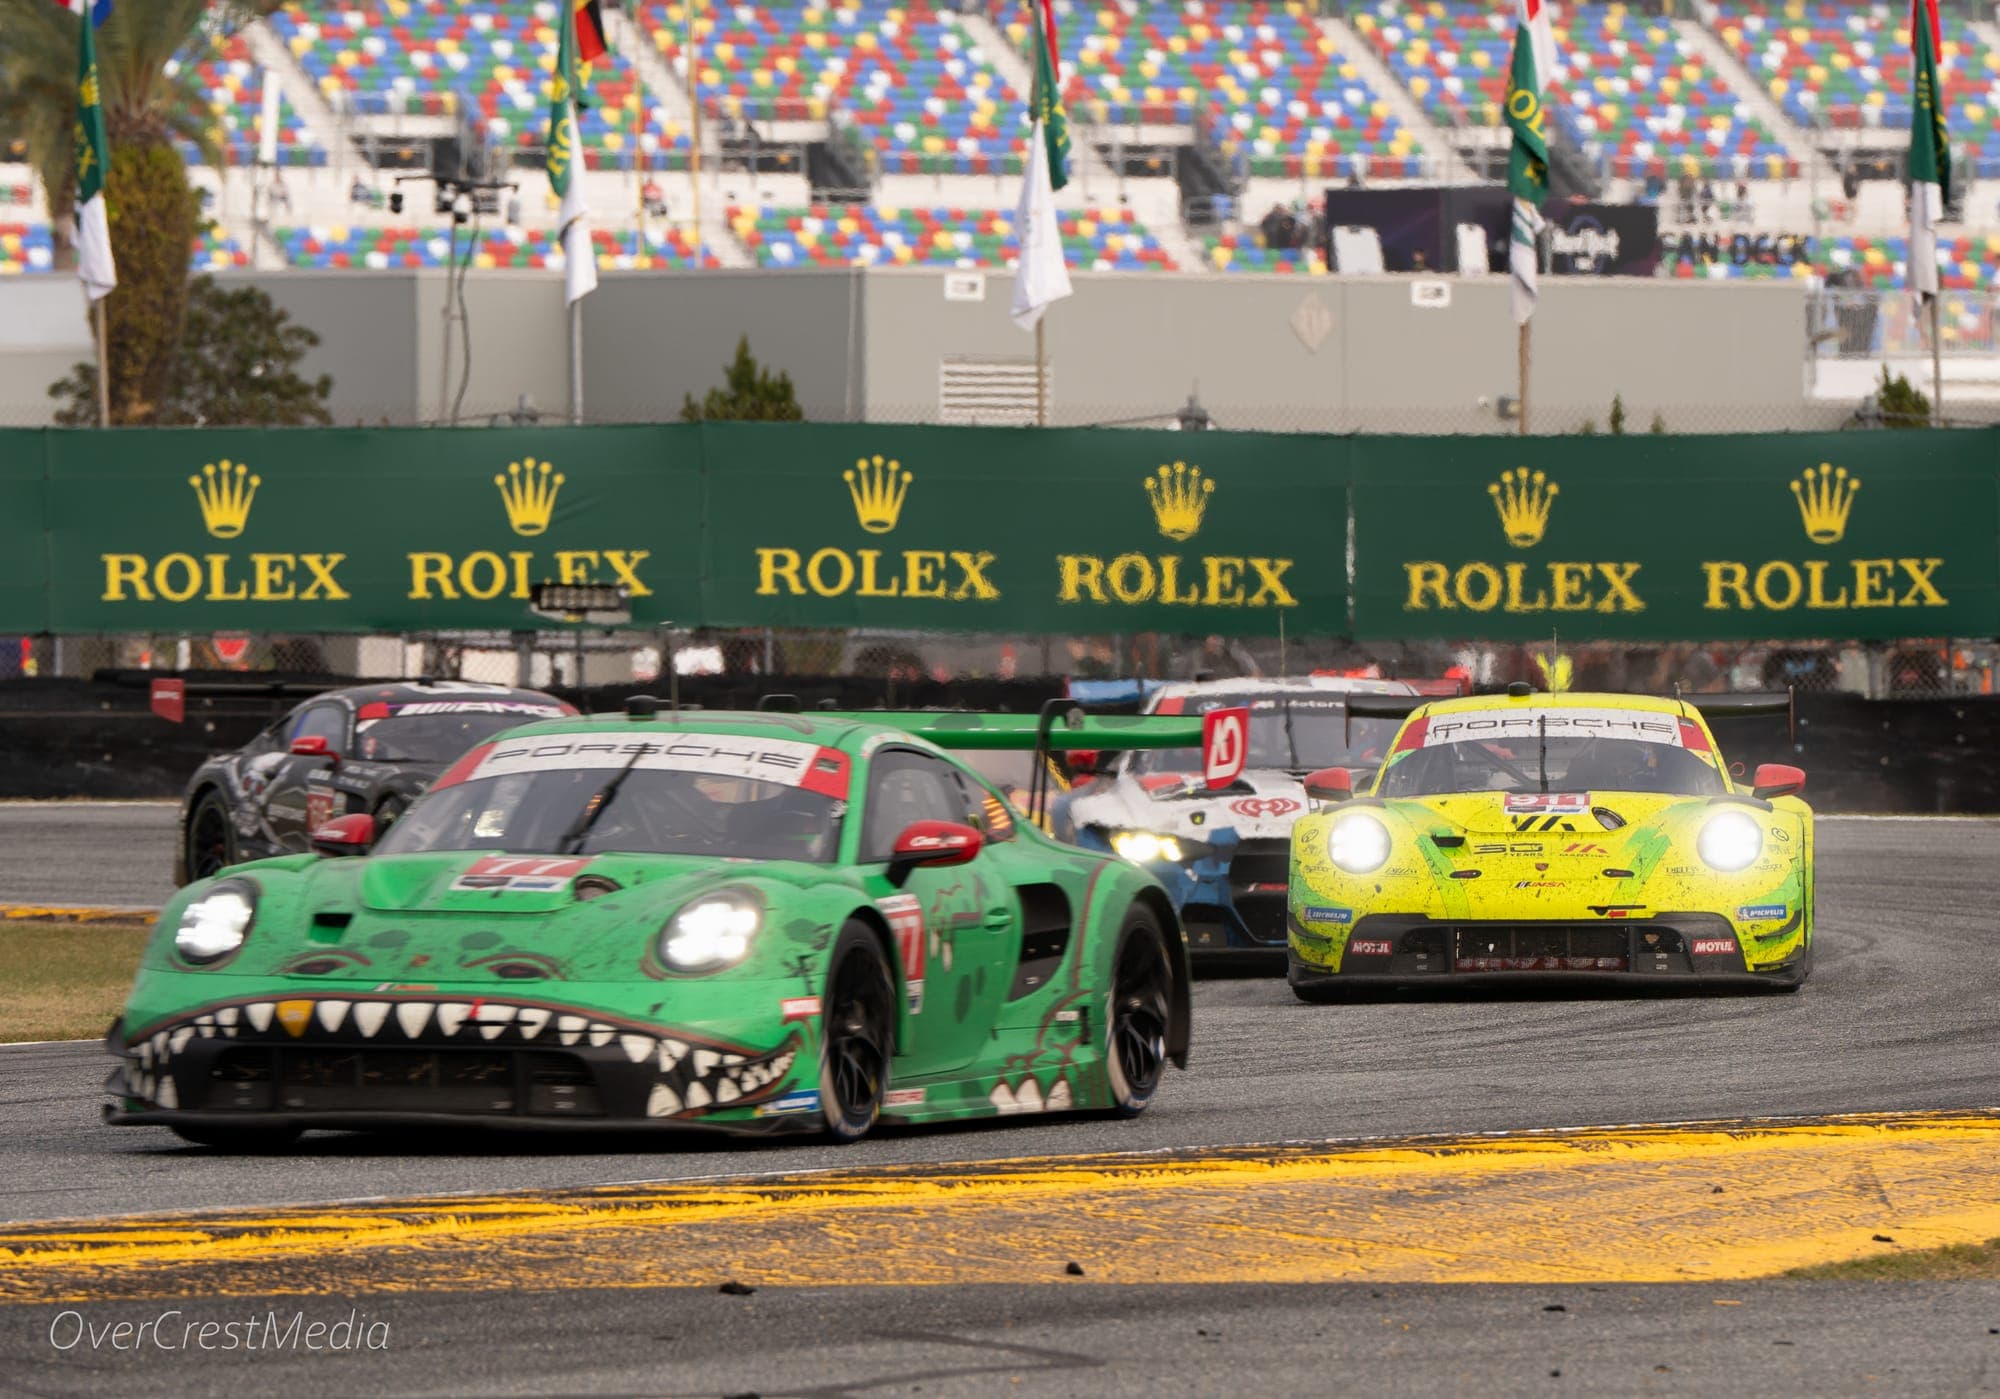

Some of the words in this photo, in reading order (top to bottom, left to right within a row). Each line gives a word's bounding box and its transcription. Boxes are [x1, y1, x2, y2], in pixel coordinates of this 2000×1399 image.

[102, 552, 349, 602] ROLEX
[407, 549, 651, 600] ROLEX
[755, 546, 1000, 601] ROLEX
[1057, 553, 1297, 606] ROLEX
[1404, 560, 1645, 613] ROLEX
[1702, 557, 1948, 610] ROLEX
[1433, 717, 1674, 737] PORSCHE
[487, 742, 804, 769] PORSCHE
[484, 858, 579, 875] 77
[1749, 908, 1785, 918] MICHELIN
[1352, 941, 1390, 954] MOTUL
[1694, 941, 1735, 953] MOTUL
